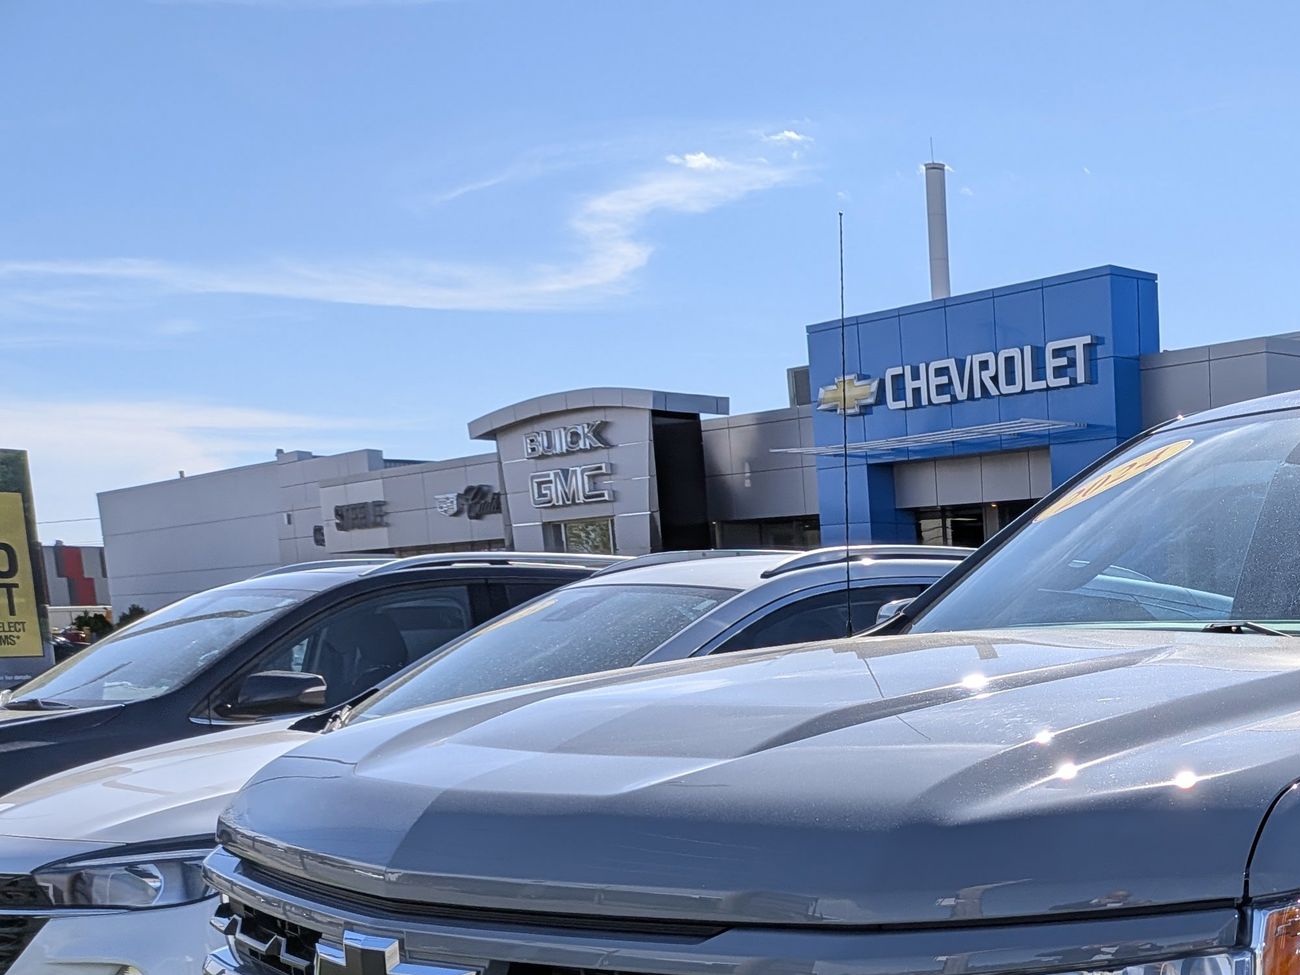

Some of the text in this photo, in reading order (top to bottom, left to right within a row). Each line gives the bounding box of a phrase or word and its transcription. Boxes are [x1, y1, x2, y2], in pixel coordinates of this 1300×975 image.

[885, 334, 1093, 410] CHEVROLET
[523, 420, 605, 459] BUICK
[529, 463, 612, 507] GMC
